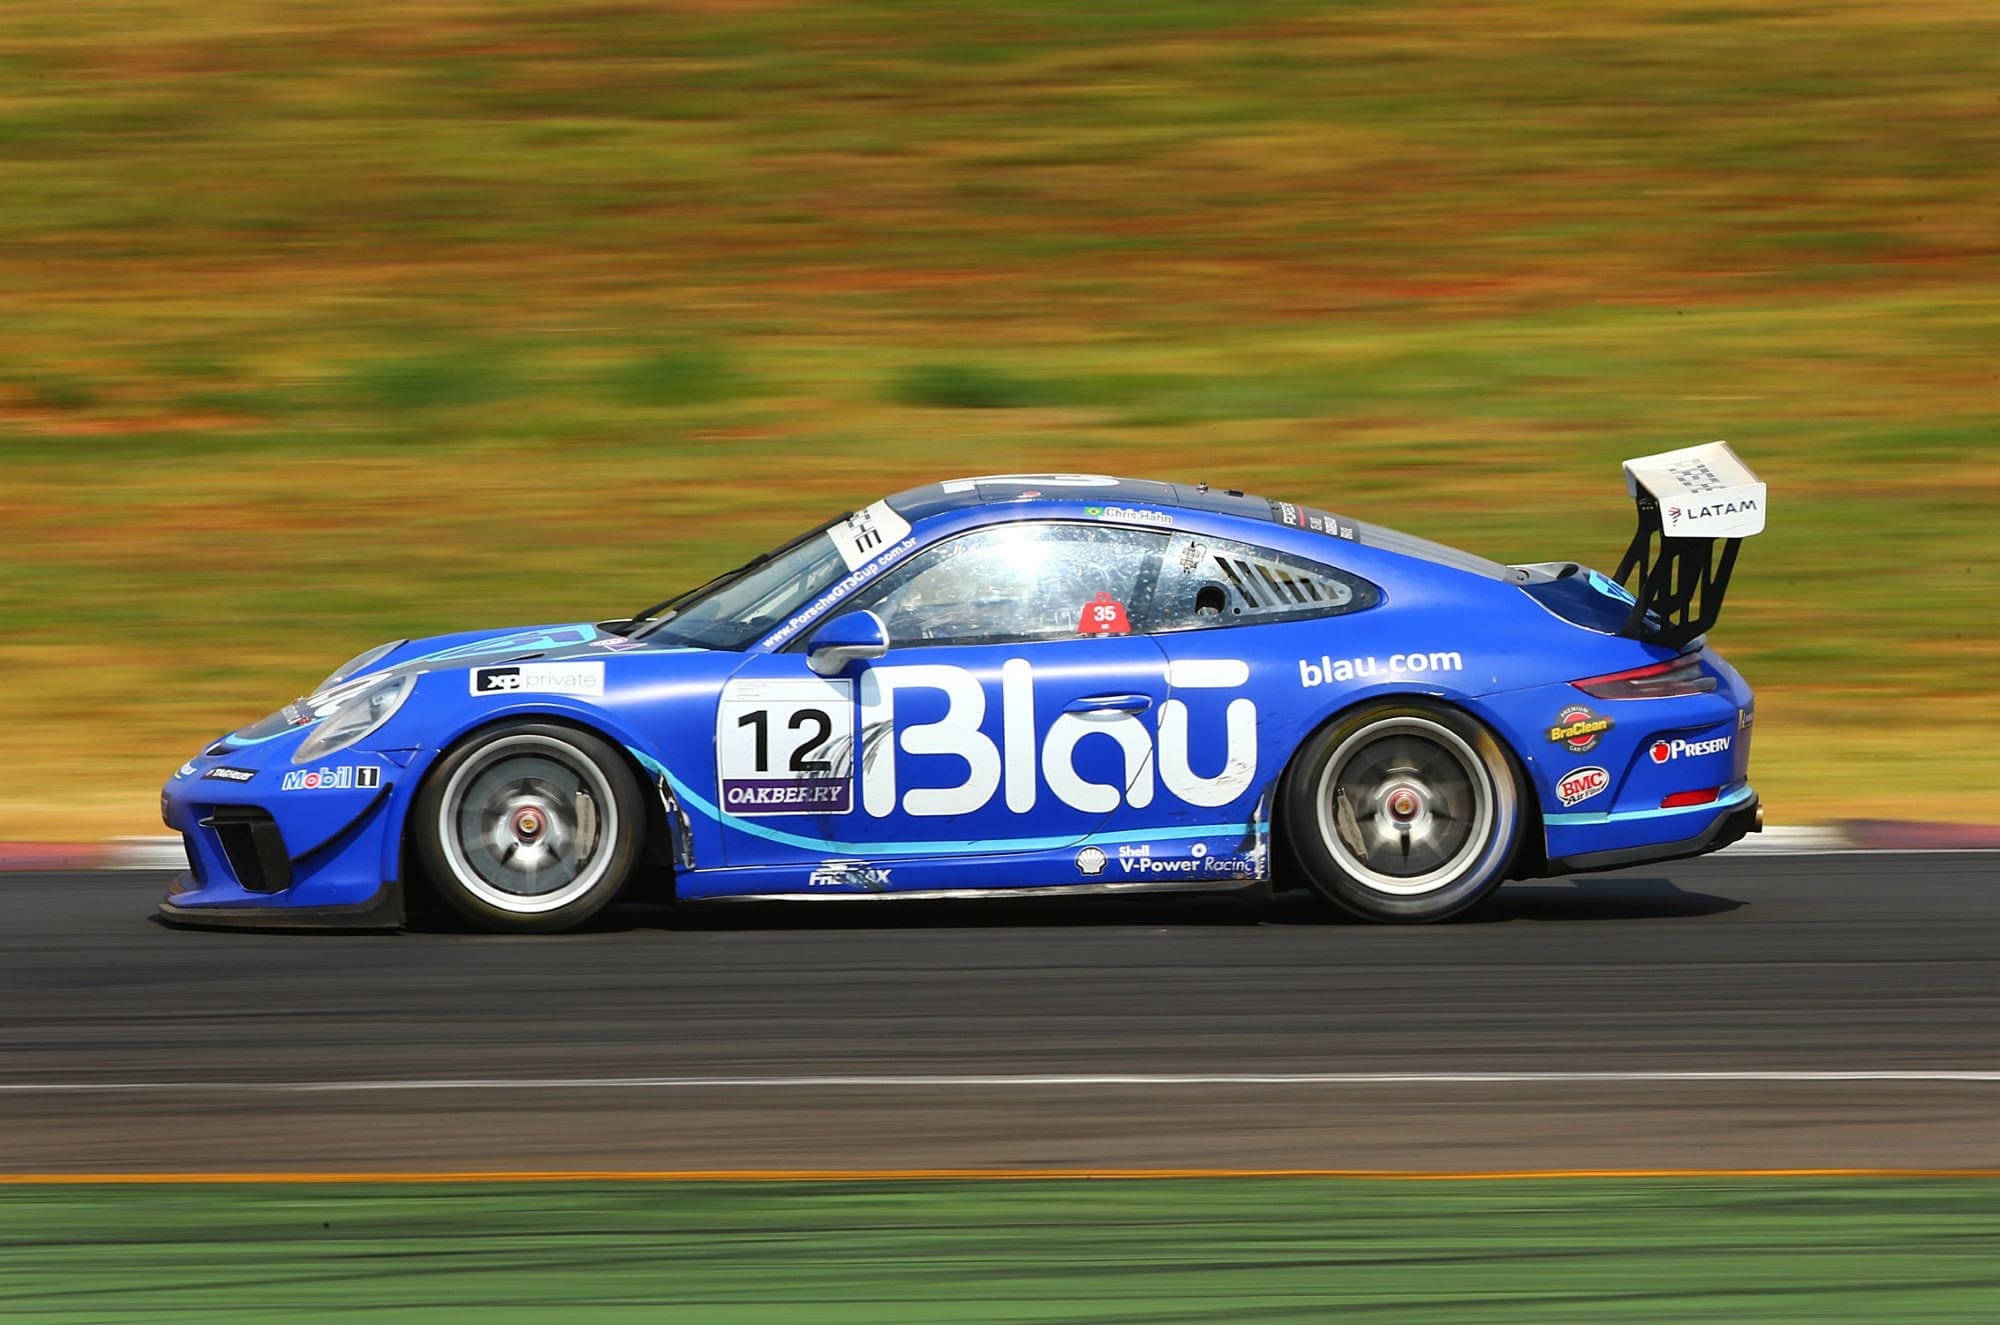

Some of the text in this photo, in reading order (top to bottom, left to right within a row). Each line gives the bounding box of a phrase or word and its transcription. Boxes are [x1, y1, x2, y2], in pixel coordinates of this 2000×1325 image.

[1105, 508, 1172, 524] Chris Hahn
[1687, 499, 1758, 520] LATAM
[1093, 605, 1116, 622] 35
[1298, 651, 1464, 688] blau.com
[526, 671, 597, 690] private
[738, 708, 832, 772] 12
[1551, 720, 1608, 741] BraClean
[281, 767, 352, 791] Mobil
[1561, 772, 1604, 798] BMC
[1118, 845, 1151, 858] Shell
[1119, 858, 1201, 873] V-Power
